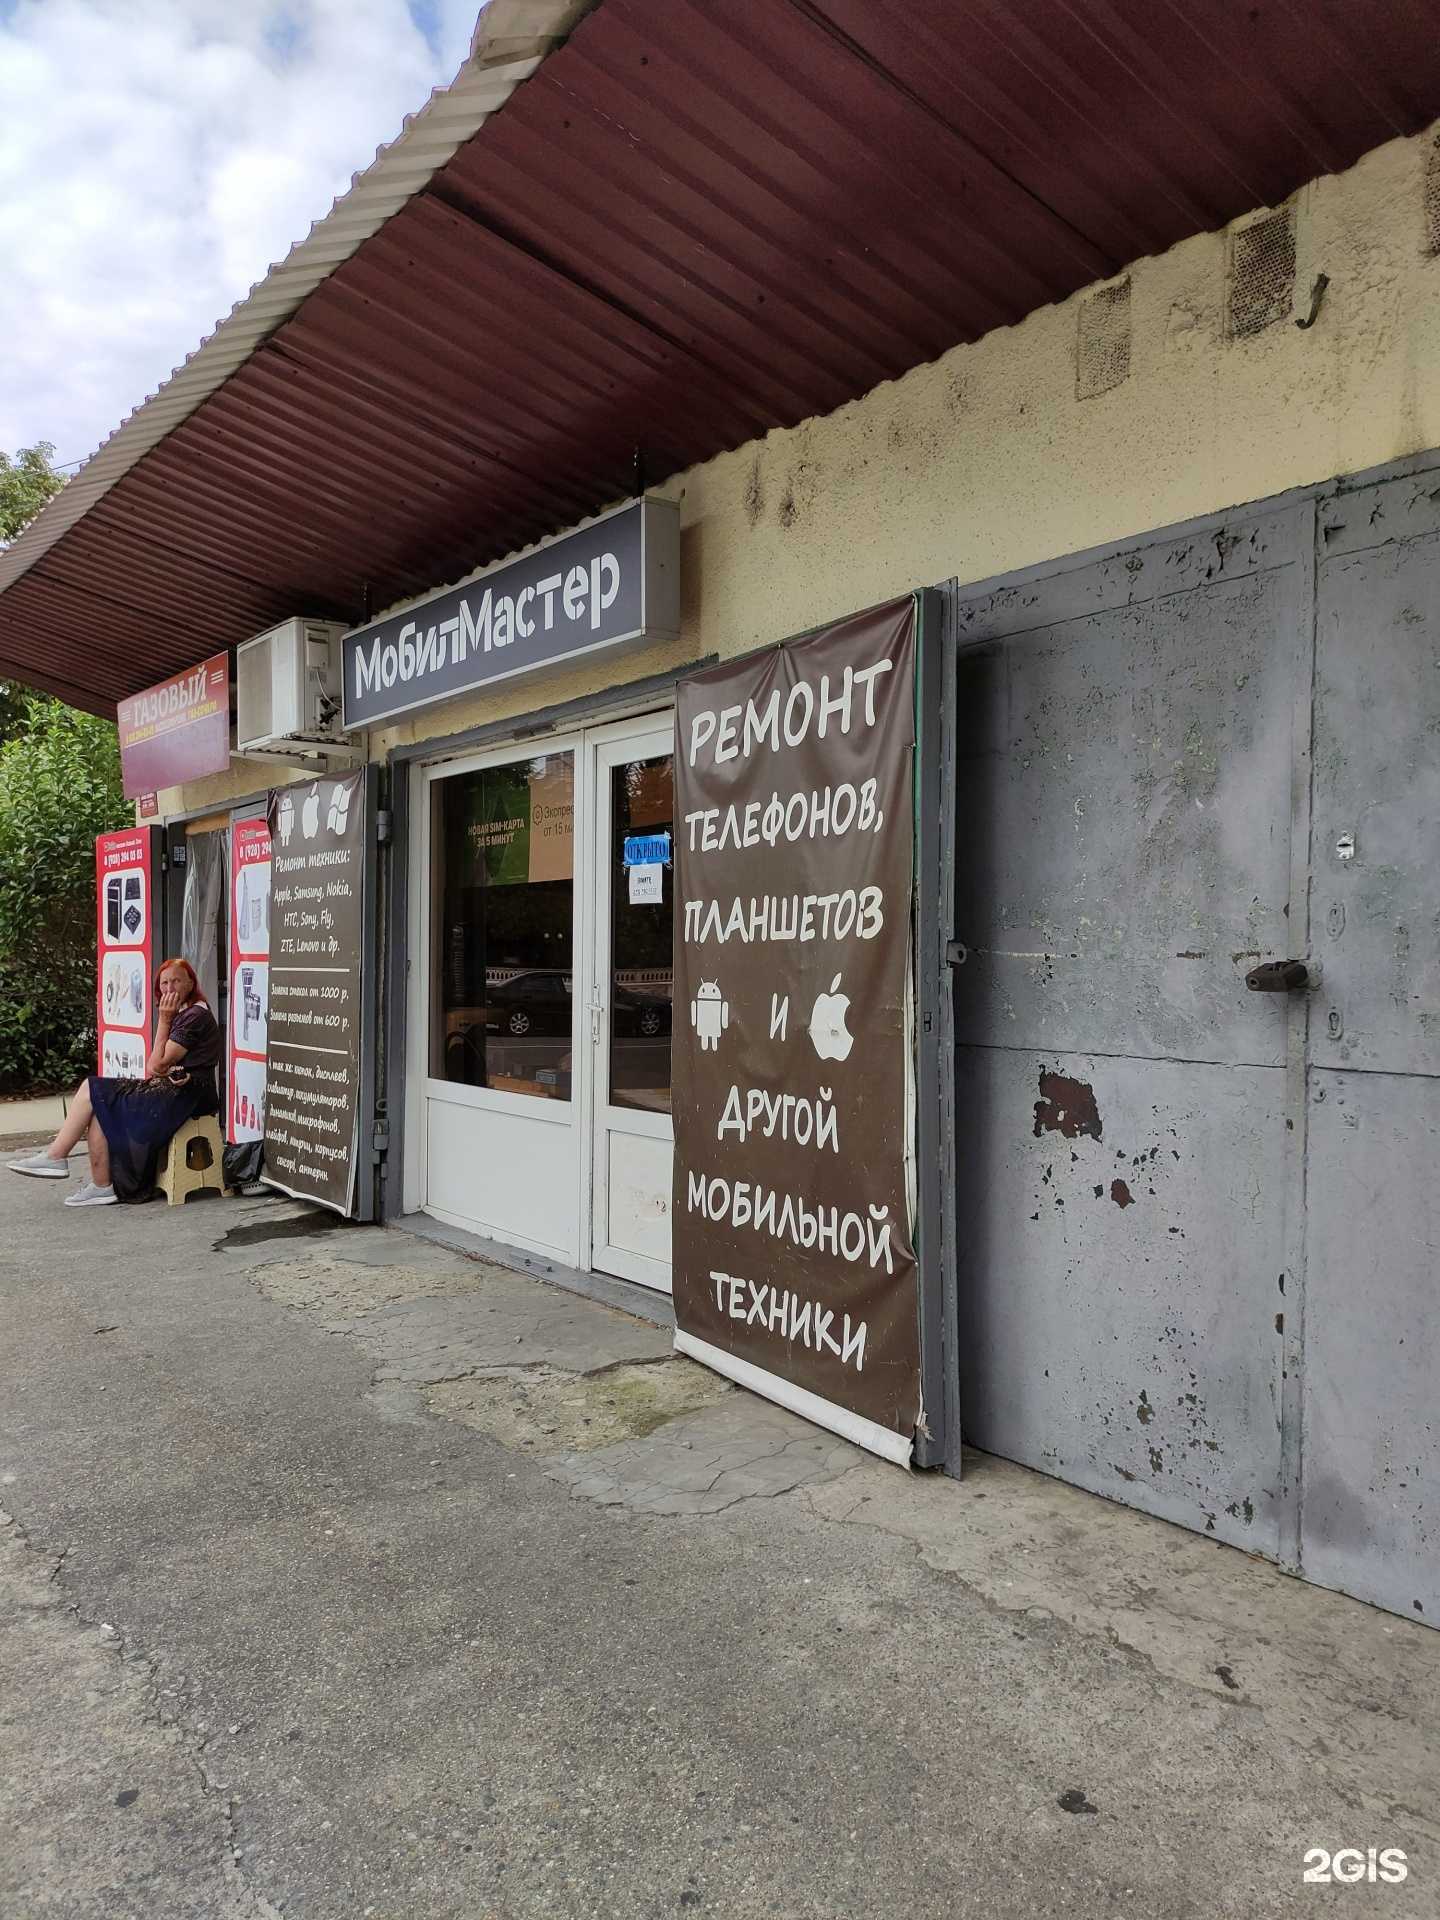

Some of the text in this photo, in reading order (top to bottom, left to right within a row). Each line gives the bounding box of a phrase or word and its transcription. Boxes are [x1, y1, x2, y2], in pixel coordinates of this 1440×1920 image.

[355, 552, 621, 699] МобилМастер
[133, 664, 208, 728] ГАЗОВЫЙ
[689, 658, 893, 768] РЕМОНТ
[684, 777, 884, 852] ТЕЛЕФОНОВ,
[275, 849, 350, 873] Ремонт техники:
[274, 879, 352, 908] Apple, Samsung, Nokia,
[284, 908, 334, 930] HTC, Sony, Fly,
[684, 886, 884, 944] ПЛАНШЕТОВ
[280, 938, 295, 954] ZTE,
[296, 938, 319, 953] Lenovo
[324, 1015, 340, 1027] 600
[315, 1064, 350, 1085] дисплеев,
[717, 1085, 839, 1153] ДРУГОЙ
[314, 1143, 349, 1163] корпусов,
[687, 1169, 894, 1275] МОБИЛЬНОЙ
[709, 1270, 867, 1372] ТЕХНИКИ
